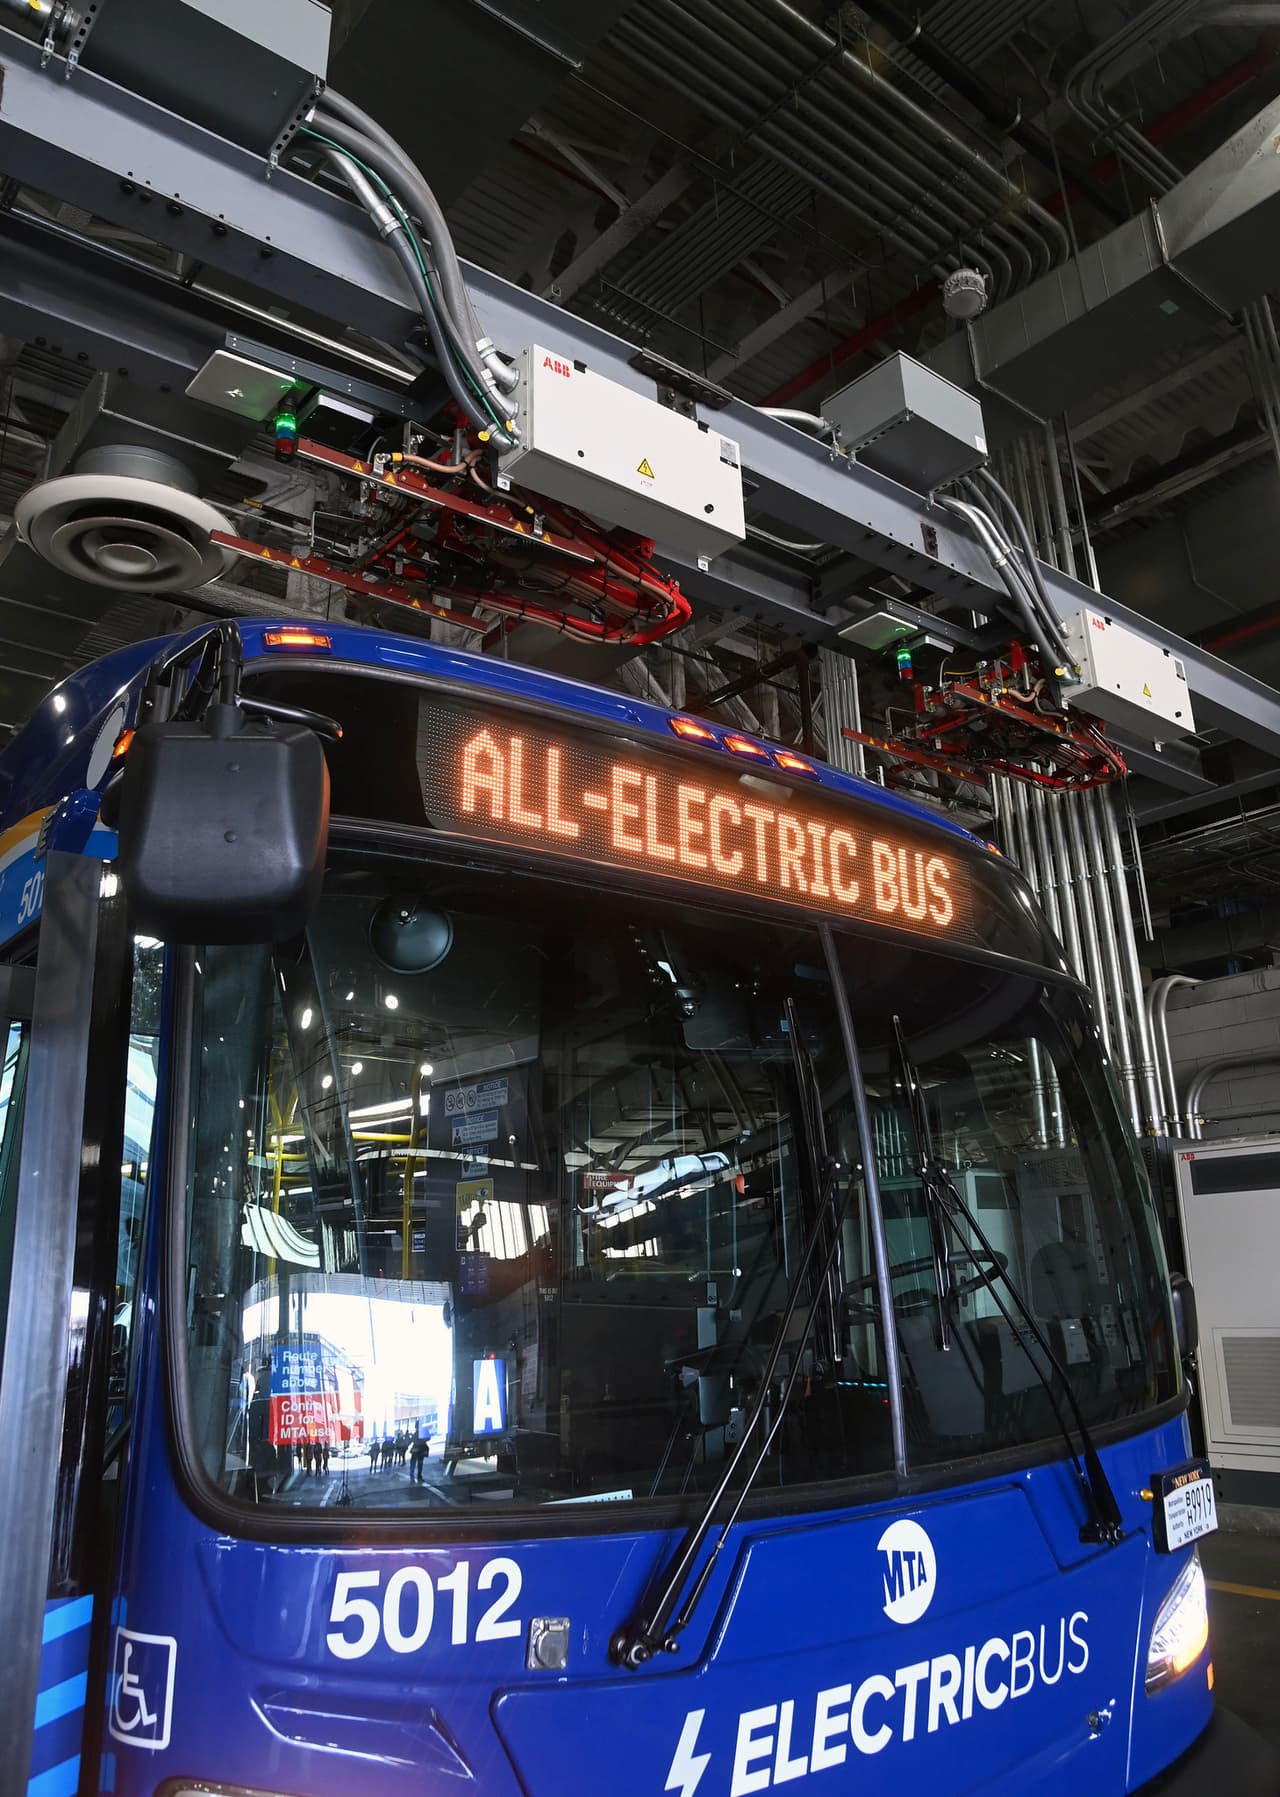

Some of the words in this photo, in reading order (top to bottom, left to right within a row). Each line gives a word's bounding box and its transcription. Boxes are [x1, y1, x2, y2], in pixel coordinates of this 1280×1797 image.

[543, 356, 570, 378] ABB
[1092, 618, 1105, 631] ABB
[461, 730, 860, 904] ALL-ELECTRIC
[872, 842, 954, 926] BUS
[17, 871, 45, 924] 501
[1181, 1152, 1196, 1161] ABB
[282, 1350, 318, 1362] Route
[281, 1378, 318, 1388] above
[473, 1360, 503, 1433] A
[281, 1414, 295, 1425] ID
[298, 1413, 316, 1425] for
[280, 1427, 307, 1439] MTA
[1174, 1473, 1188, 1489] NEW
[1187, 1470, 1201, 1483] YORK
[1183, 1531, 1193, 1540] NEW
[1193, 1524, 1204, 1536] YORK
[879, 1549, 927, 1606] MTA
[326, 1557, 523, 1659] 5012
